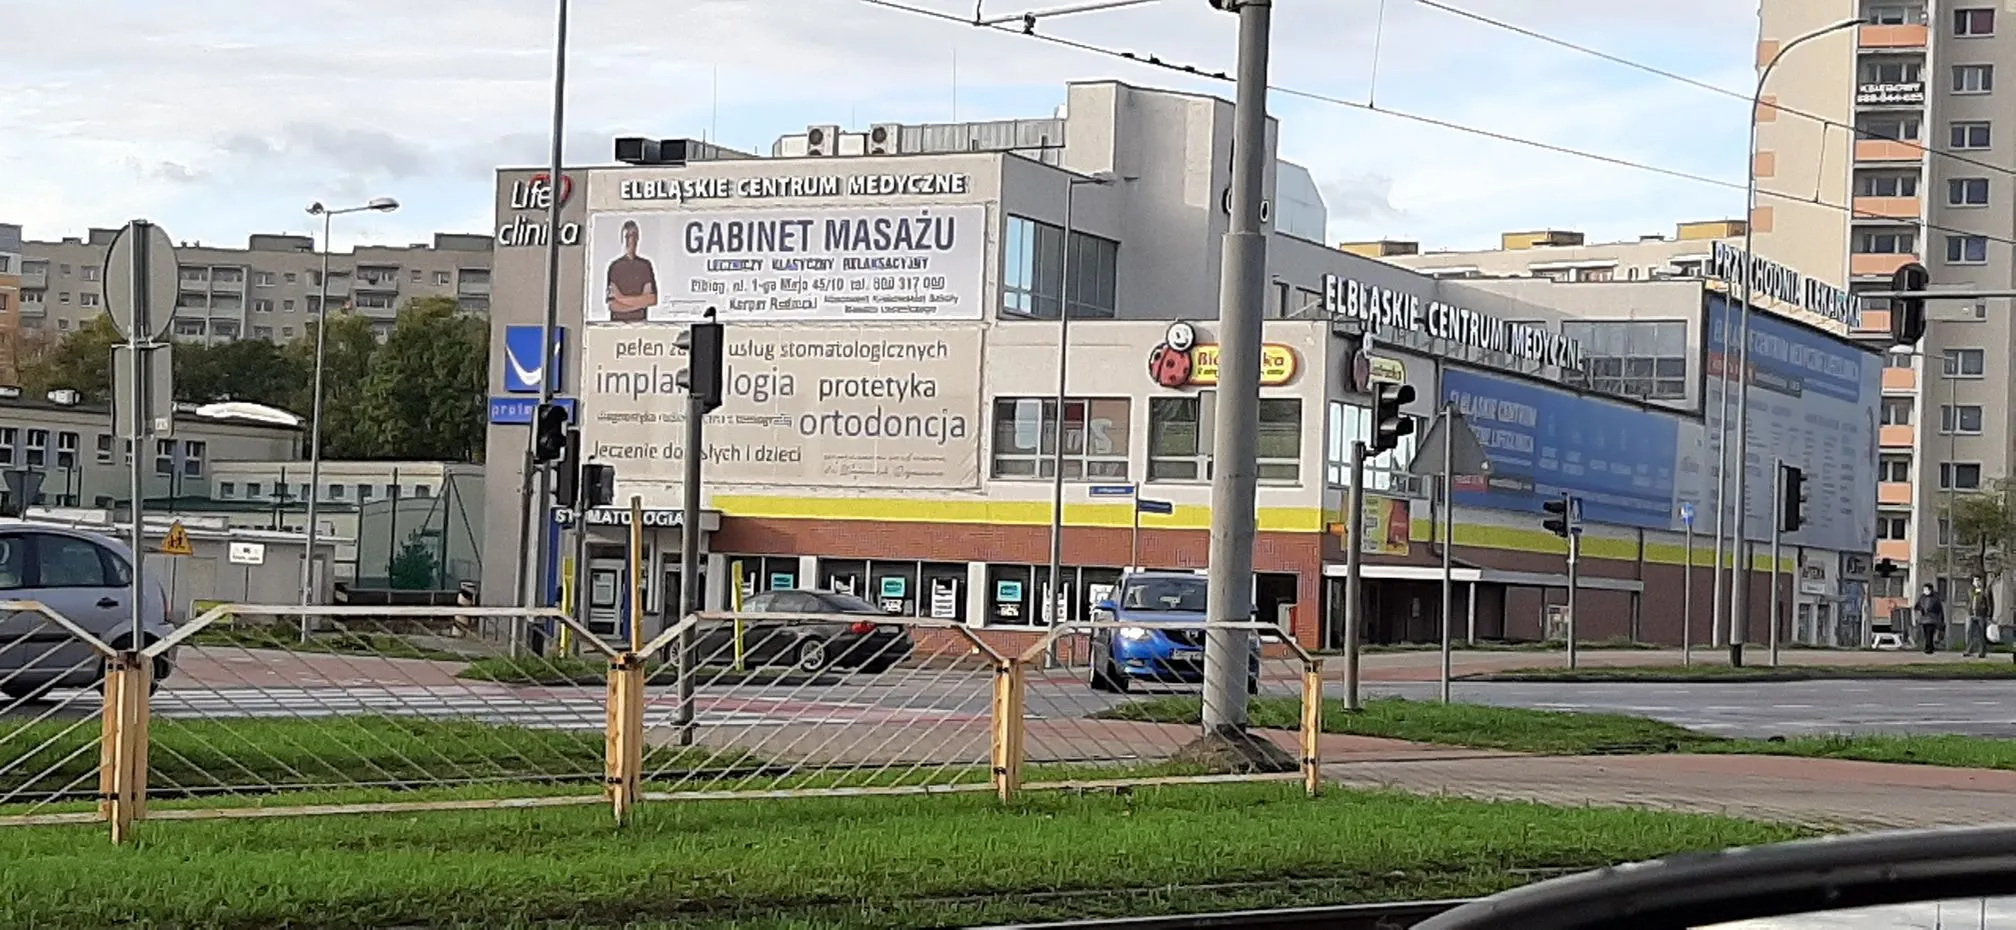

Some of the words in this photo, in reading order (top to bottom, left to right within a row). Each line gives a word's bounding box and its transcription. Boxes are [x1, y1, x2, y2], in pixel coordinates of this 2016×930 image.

[511, 180, 551, 209] Life
[620, 178, 729, 203] ELBLĄSKIE
[737, 176, 841, 197] CENTRUM
[848, 173, 967, 196] MEDYCZNE
[500, 215, 579, 246] clinia
[685, 220, 814, 253] GABINET
[825, 209, 955, 251] MASAŻU
[1324, 273, 1419, 335] ELBLĄSKIE
[1428, 301, 1503, 351] CENTRUM
[1511, 323, 1583, 371] MEDYCZNE
[780, 339, 948, 362] stomatologicznych
[597, 365, 794, 402] implalogia
[819, 373, 936, 402] protetyka
[800, 405, 966, 445] ortodoncja
[593, 440, 657, 460] leczenie
[663, 441, 741, 464] dosłych
[755, 444, 801, 462] dzieci
[555, 508, 684, 526] STMATOOGIA
